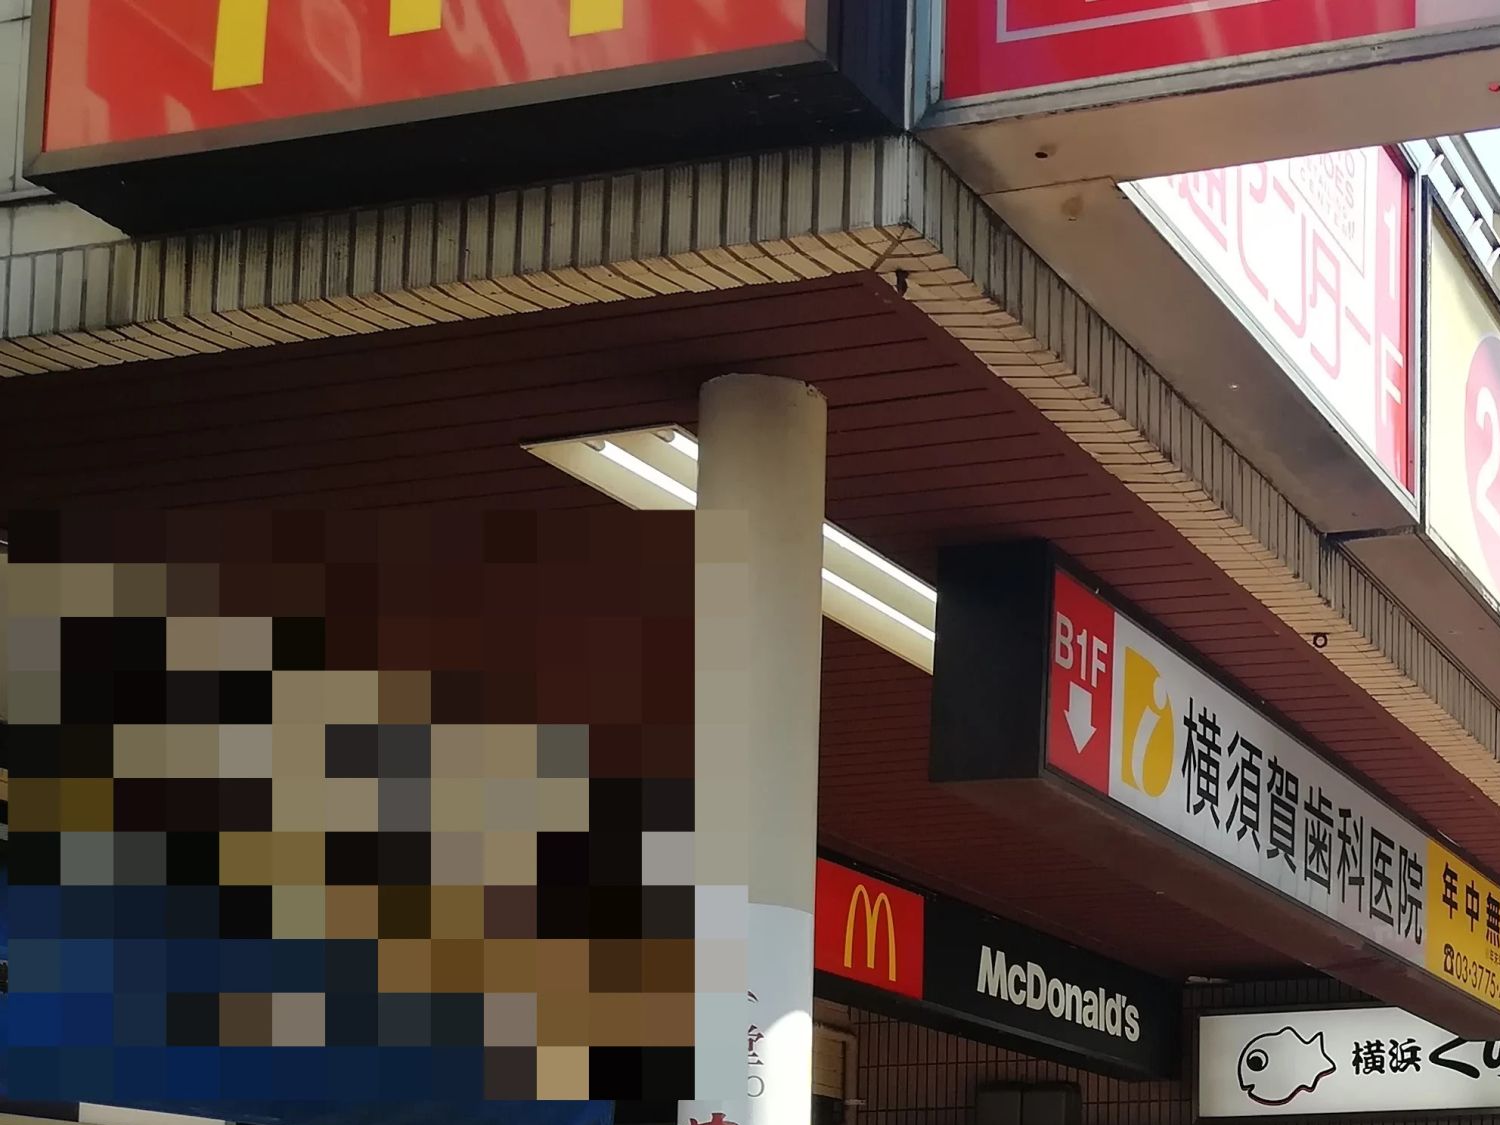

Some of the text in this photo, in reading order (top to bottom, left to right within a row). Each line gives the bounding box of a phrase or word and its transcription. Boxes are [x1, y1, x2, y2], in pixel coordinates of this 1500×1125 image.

[1054, 608, 1108, 687] B1F
[1180, 695, 1423, 945] 横須賀歯科医院
[976, 945, 1141, 1042] McDonald's
[1351, 1038, 1421, 1075] 横浜
